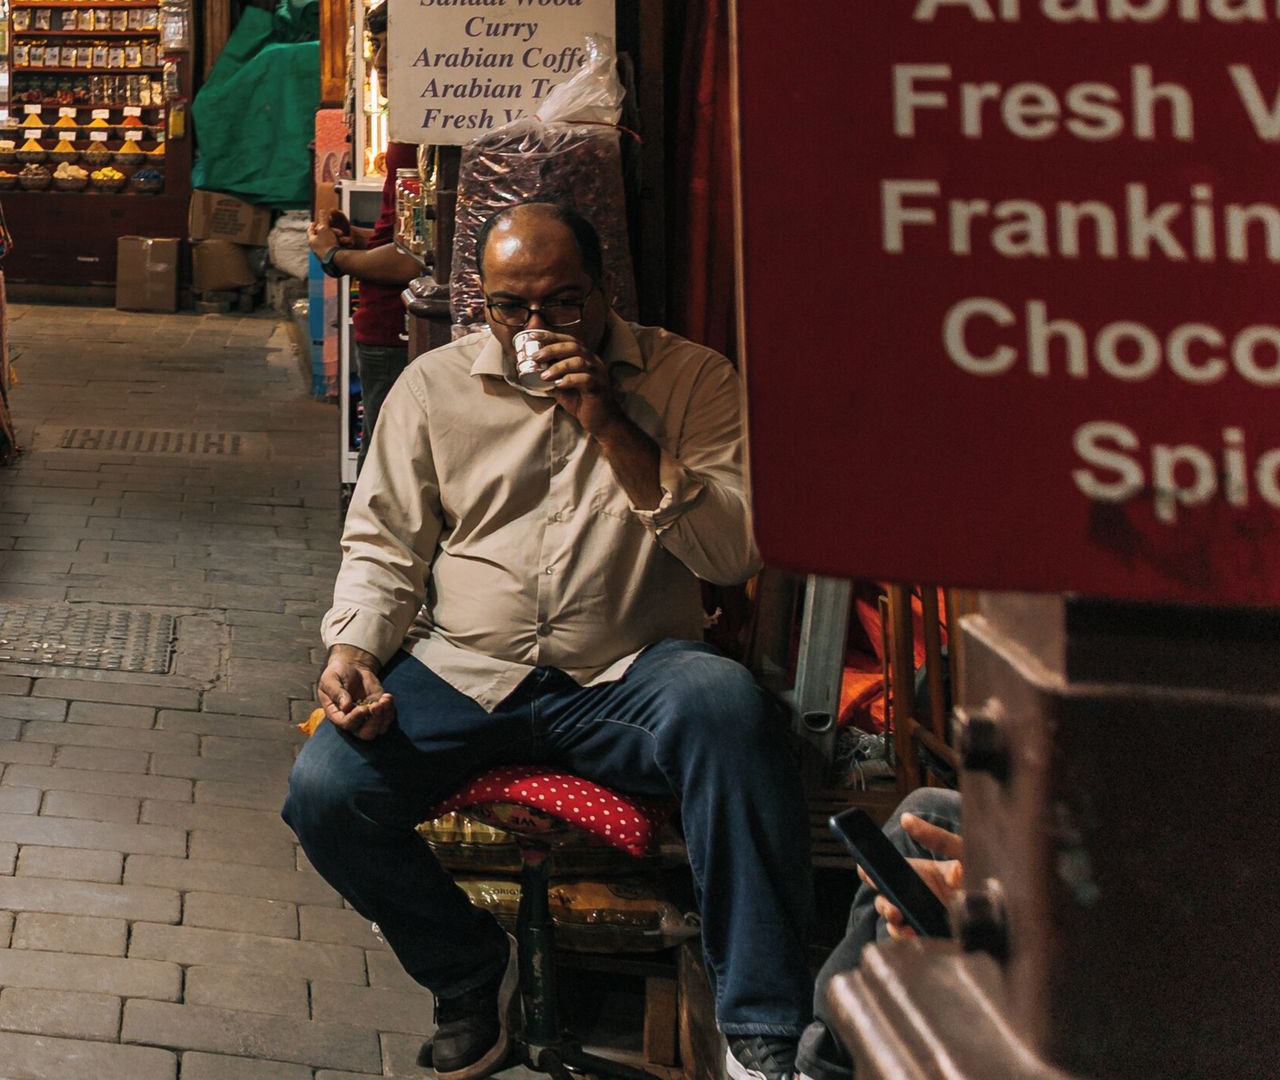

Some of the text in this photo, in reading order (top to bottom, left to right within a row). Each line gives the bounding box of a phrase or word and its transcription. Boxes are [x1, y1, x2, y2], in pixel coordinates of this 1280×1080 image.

[465, 16, 538, 42] Curry
[412, 47, 514, 68] Arabian
[420, 78, 522, 99] Arabian
[891, 63, 1194, 142] Fresh
[420, 108, 494, 129] Fresh
[880, 179, 1280, 263] Frankin
[943, 296, 1280, 387] Choco
